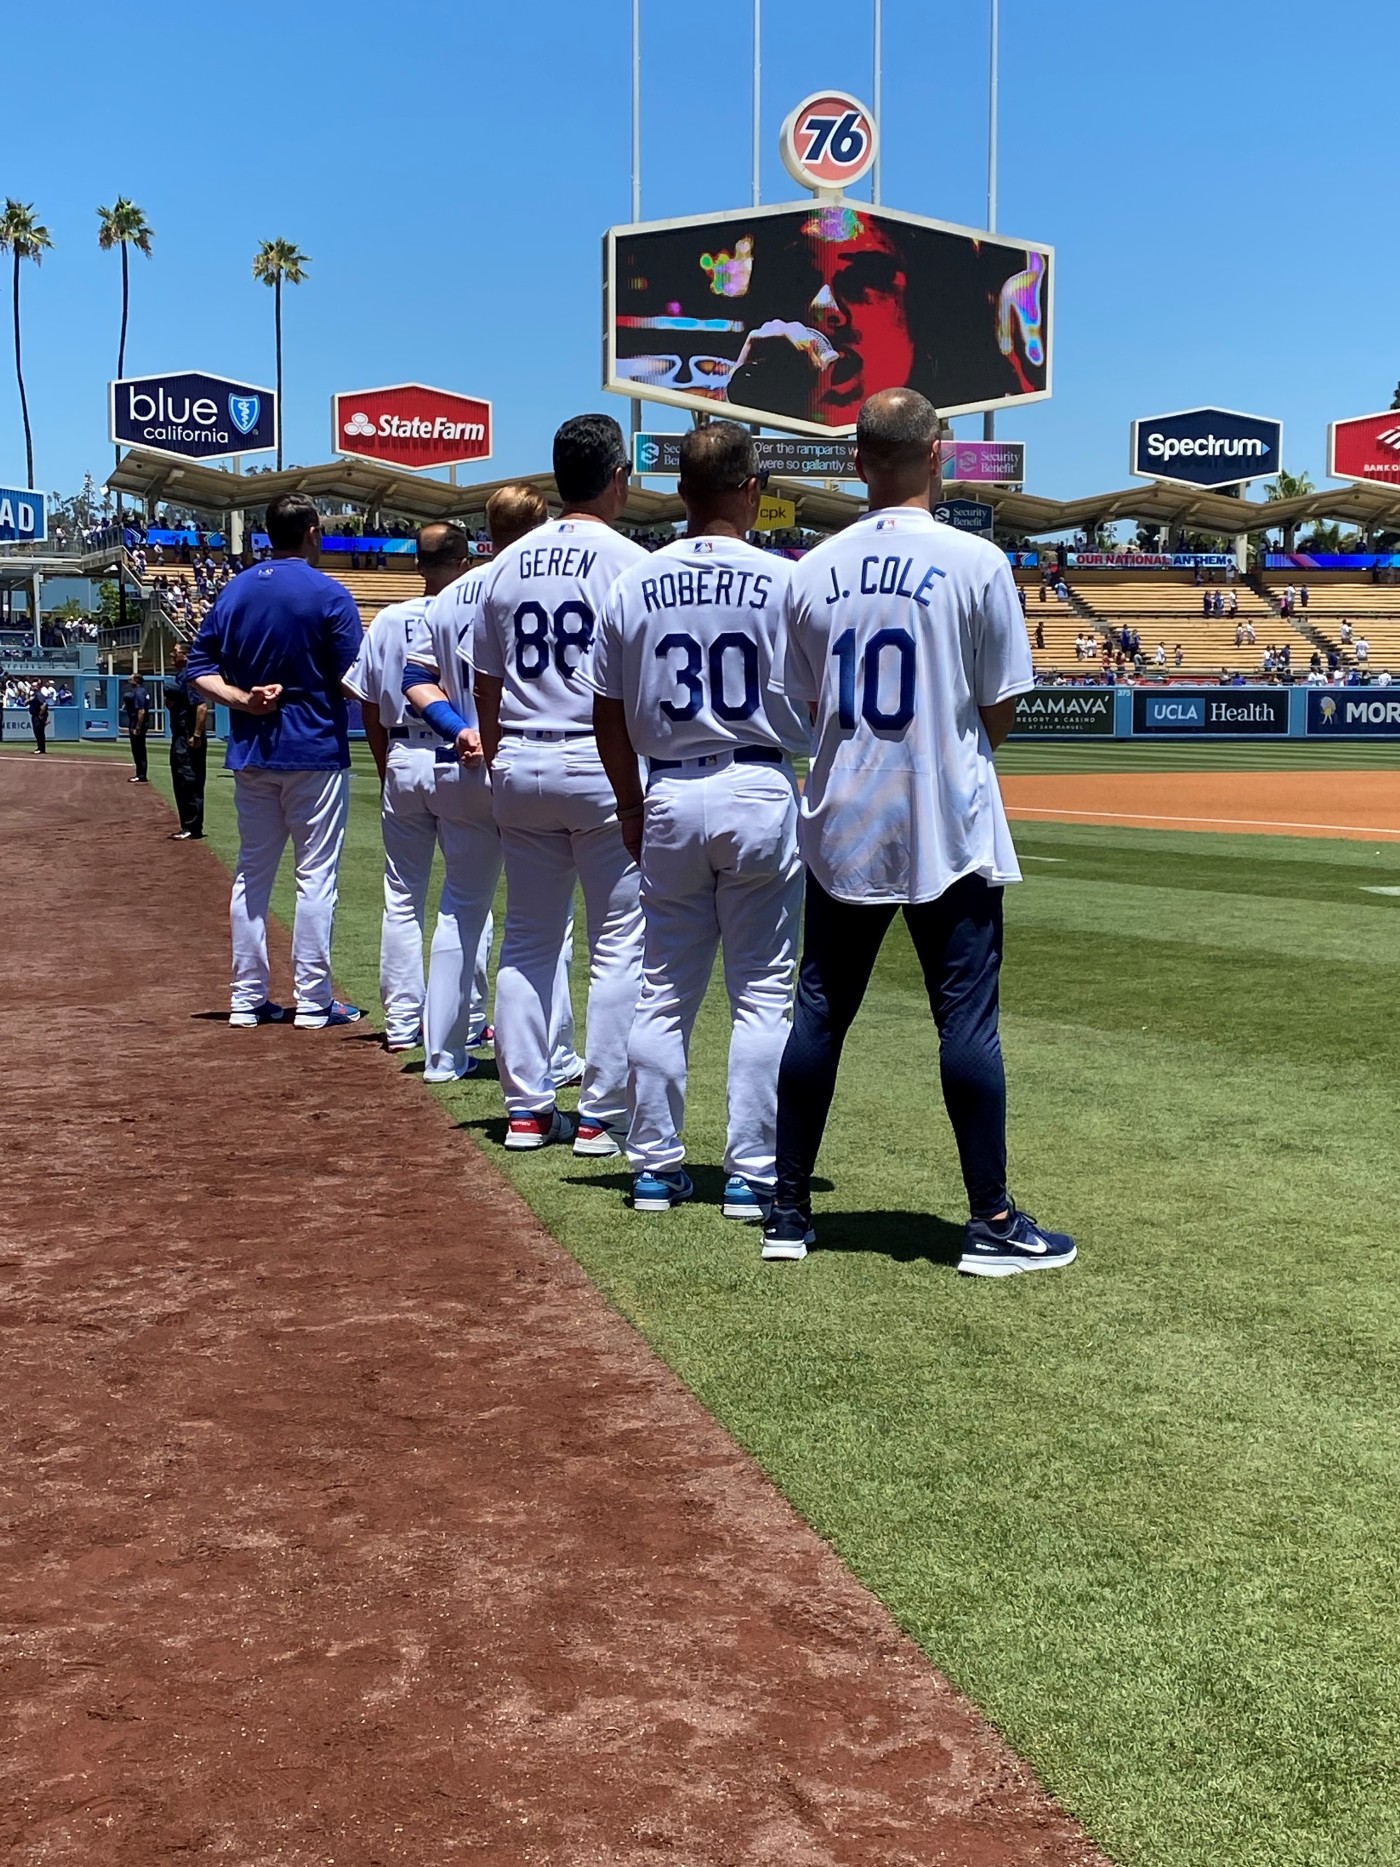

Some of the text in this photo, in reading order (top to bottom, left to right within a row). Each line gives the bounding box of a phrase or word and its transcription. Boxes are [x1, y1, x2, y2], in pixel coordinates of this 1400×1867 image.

[803, 112, 865, 164] 76
[129, 385, 218, 425] blue
[144, 426, 228, 443] california
[663, 442, 681, 454] Sec
[776, 442, 795, 454] the
[797, 444, 846, 457] ramparts
[1148, 433, 1262, 461] Spectrum
[760, 459, 784, 469] were
[786, 460, 800, 470] so
[802, 458, 845, 474] gallantly
[981, 450, 1020, 465] Security
[981, 463, 1015, 474] Benefit
[0, 498, 34, 532] AD
[760, 505, 786, 521] cpk
[953, 508, 987, 518] Security
[953, 517, 982, 527] Benefit
[520, 547, 598, 580] GEREN
[1077, 554, 1227, 566] OUR NATIONAL ANTHEM
[641, 569, 773, 613] ROBERTS
[826, 556, 947, 607] J. COLE
[513, 600, 594, 680] 88
[655, 631, 761, 722] 30
[832, 627, 917, 731] 10
[1117, 689, 1131, 697] 375
[1016, 695, 1109, 714] AAMAVA'
[1154, 702, 1275, 722] UCLA Health
[1346, 702, 1400, 723] MOR
